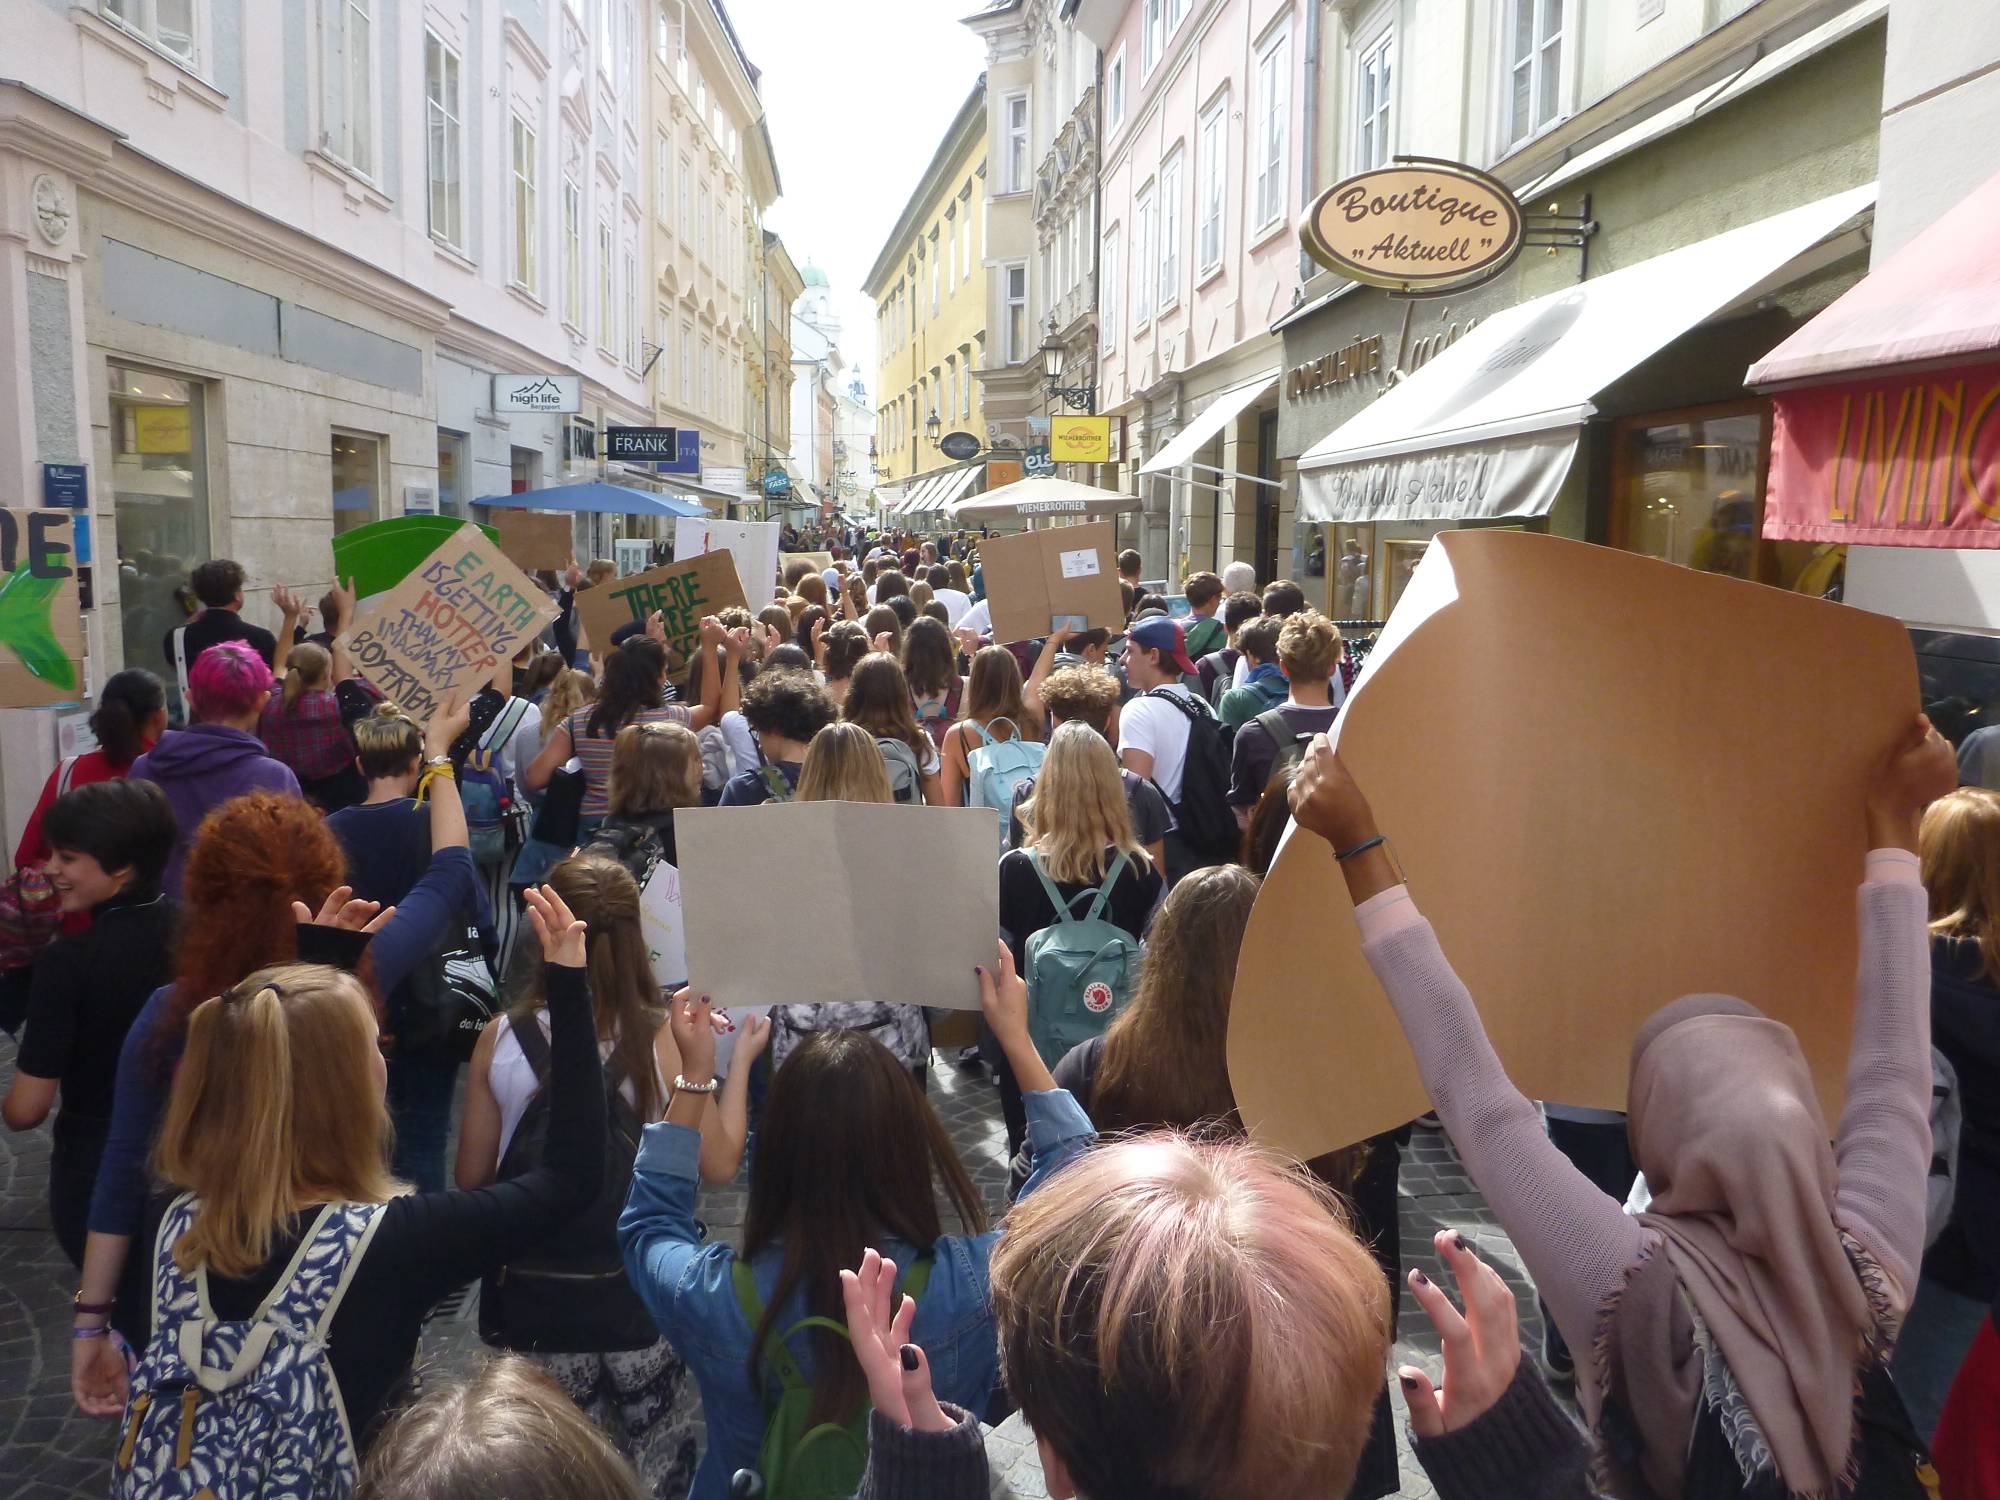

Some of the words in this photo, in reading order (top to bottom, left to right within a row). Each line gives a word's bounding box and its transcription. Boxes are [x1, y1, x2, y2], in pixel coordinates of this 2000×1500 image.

[1336, 183, 1498, 229] Boutique
[541, 393, 561, 404] life
[615, 437, 668, 452] FRANK
[680, 447, 698, 457] ITA
[1016, 500, 1087, 514] WIENERROITHER
[452, 551, 537, 631] EARTH
[608, 571, 709, 621] THERE
[376, 617, 461, 691] IMAGINARY
[399, 608, 445, 647] THAN
[437, 643, 469, 672] MY
[413, 591, 498, 673] HOTTER
[348, 630, 439, 721] BOYFRIEN
